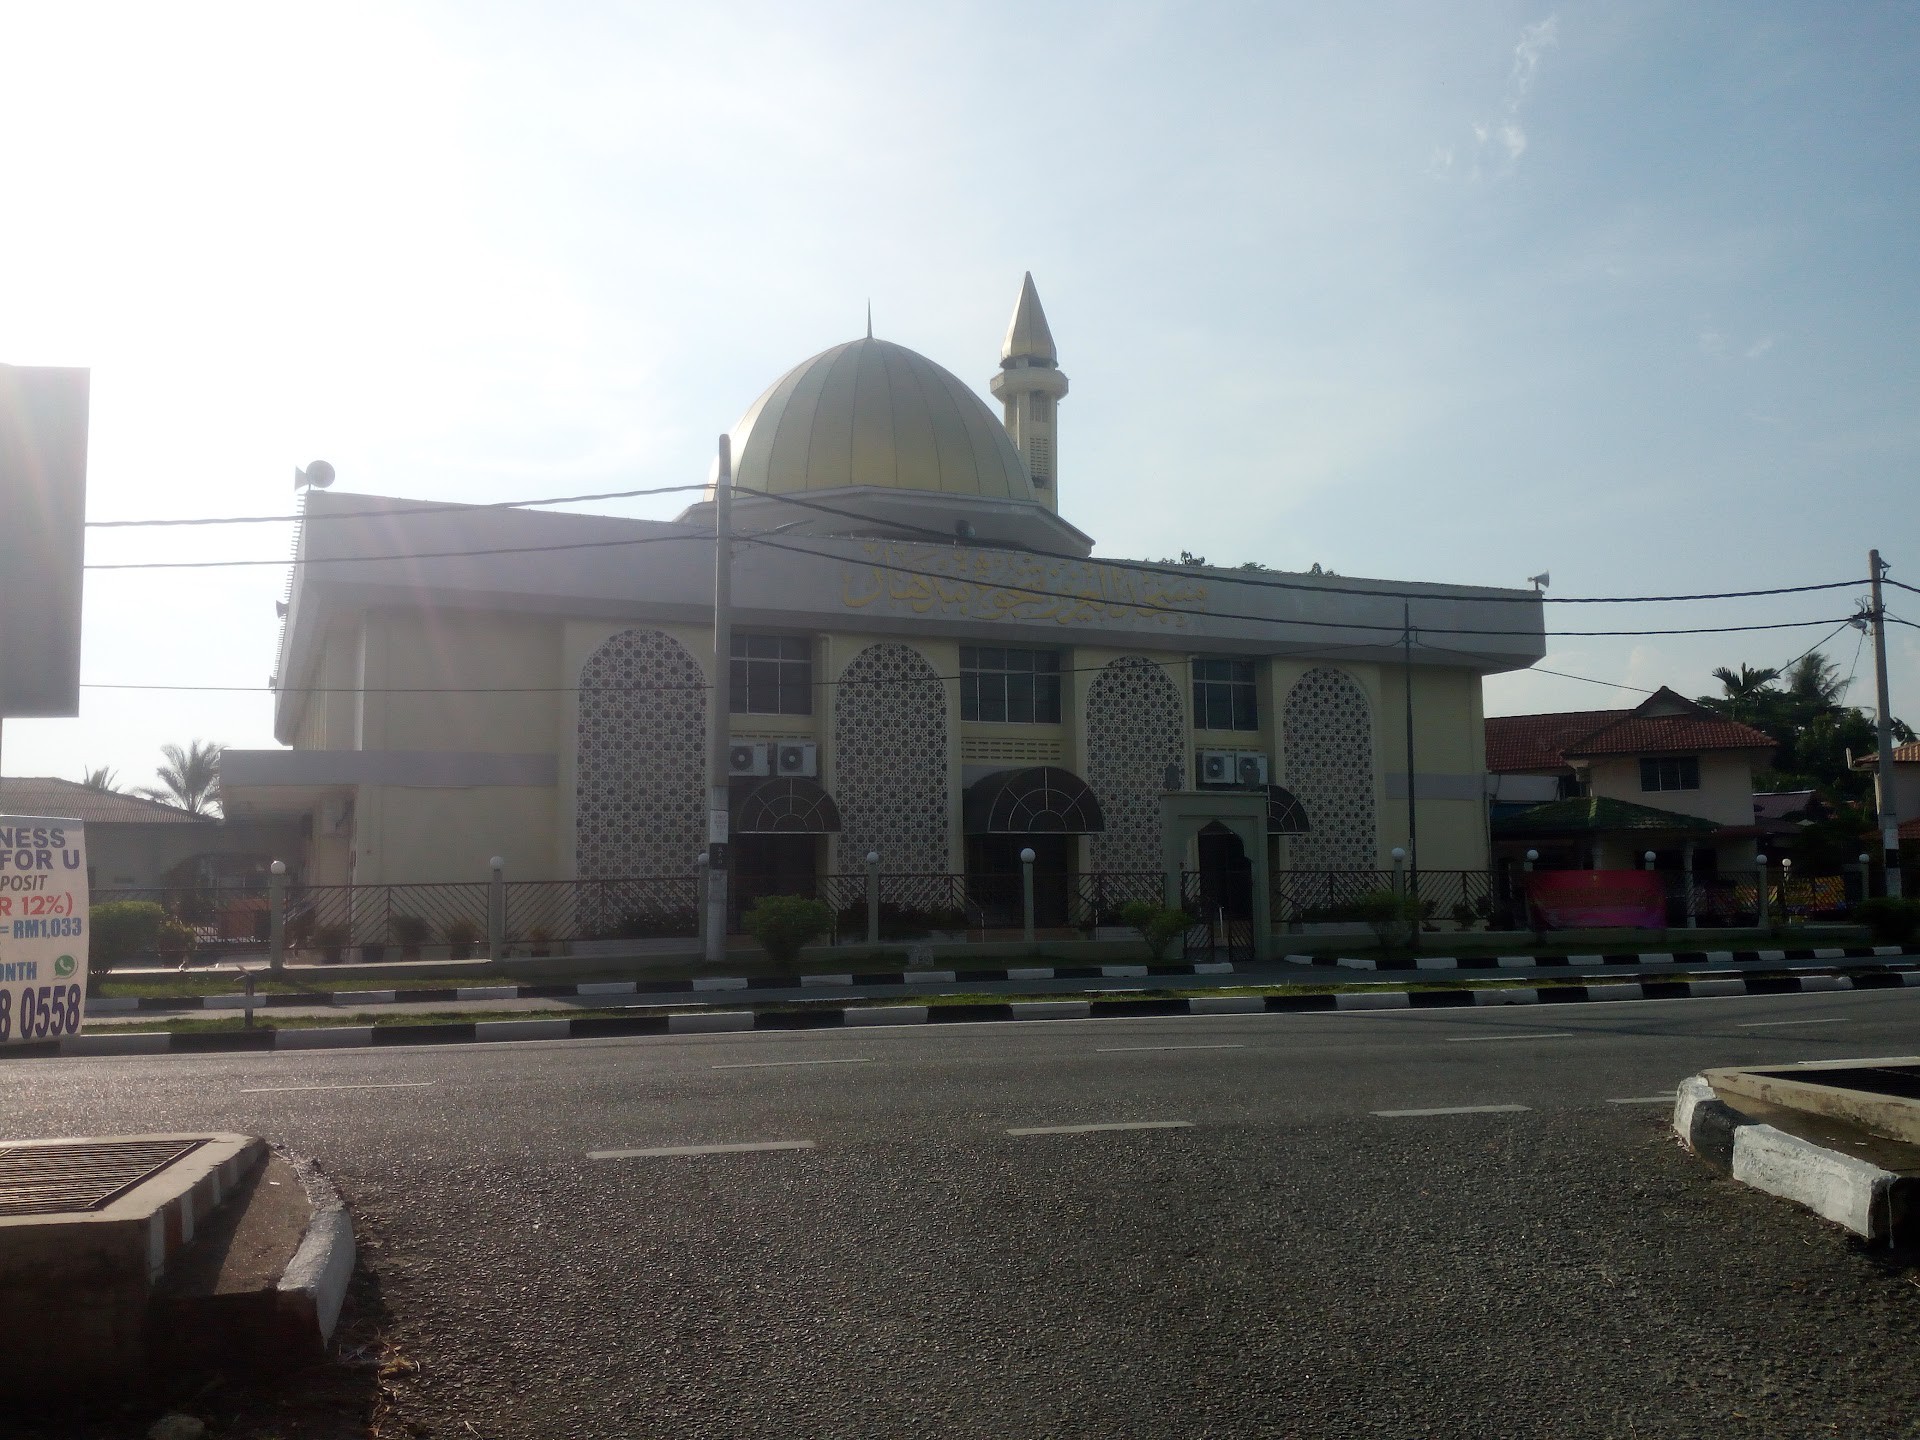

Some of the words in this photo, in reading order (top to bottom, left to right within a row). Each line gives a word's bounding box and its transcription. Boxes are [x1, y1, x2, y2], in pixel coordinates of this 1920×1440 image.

[0, 828, 65, 848] NESS
[0, 849, 53, 870] FOR
[63, 849, 80, 870] U
[0, 875, 48, 892] POSIT
[22, 892, 73, 917] 12%)
[14, 917, 82, 939] RM1,033
[21, 983, 81, 1040] 0558
